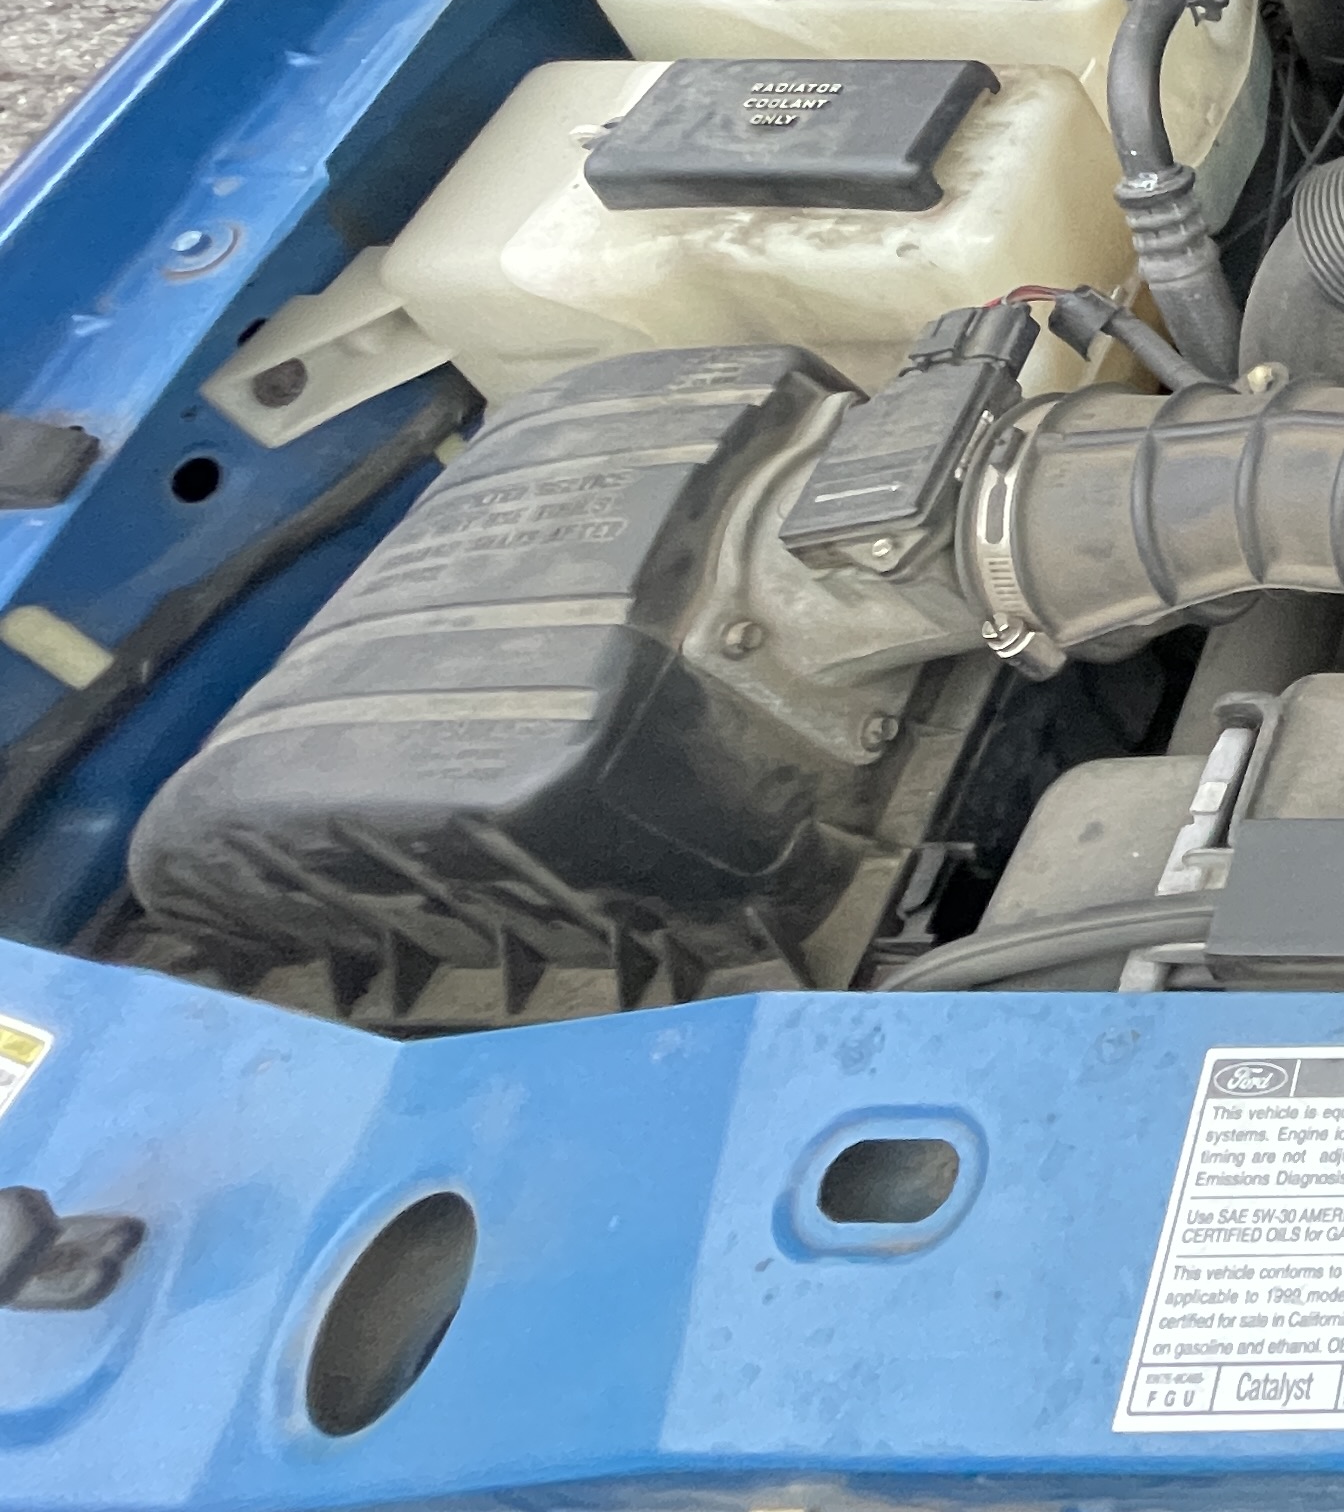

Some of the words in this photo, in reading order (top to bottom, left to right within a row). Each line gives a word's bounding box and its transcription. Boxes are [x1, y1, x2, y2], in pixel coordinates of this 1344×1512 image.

[751, 83, 842, 93] RADIATOR
[743, 98, 829, 108] COOLANT
[750, 114, 798, 125] ONLY
[1213, 1105, 1242, 1120] This
[1249, 1105, 1299, 1120] vehicle
[1304, 1105, 1317, 1119] is
[1205, 1129, 1269, 1145] systems.
[1278, 1127, 1328, 1145] Engine
[1201, 1150, 1245, 1167] timing
[1252, 1152, 1276, 1163] are
[1283, 1150, 1307, 1163] not
[1195, 1171, 1270, 1186] Emissions
[1187, 1210, 1214, 1224] Use
[1217, 1209, 1249, 1224] SAE
[1252, 1208, 1297, 1224] 5W-30
[1182, 1228, 1263, 1244] CERTIFIED
[1266, 1226, 1301, 1242] OILS
[1305, 1226, 1323, 1241] for
[1173, 1265, 1202, 1280] This
[1207, 1264, 1255, 1280] vehicle
[1259, 1264, 1324, 1280] conforms
[1329, 1265, 1343, 1279] to
[1165, 1289, 1239, 1308] applicable
[1245, 1290, 1259, 1304] to
[1159, 1313, 1215, 1329] certified
[1217, 1313, 1237, 1328] for
[1239, 1313, 1269, 1328] sale
[1272, 1313, 1285, 1328] in
[1153, 1343, 1171, 1355] on
[1174, 1339, 1234, 1359] gasoline
[1237, 1339, 1265, 1354] and
[1268, 1338, 1322, 1354] ethanol.
[1235, 1372, 1314, 1408] Catalyst
[1147, 1390, 1157, 1408] F
[1164, 1390, 1175, 1407] G
[1183, 1390, 1194, 1408] U
